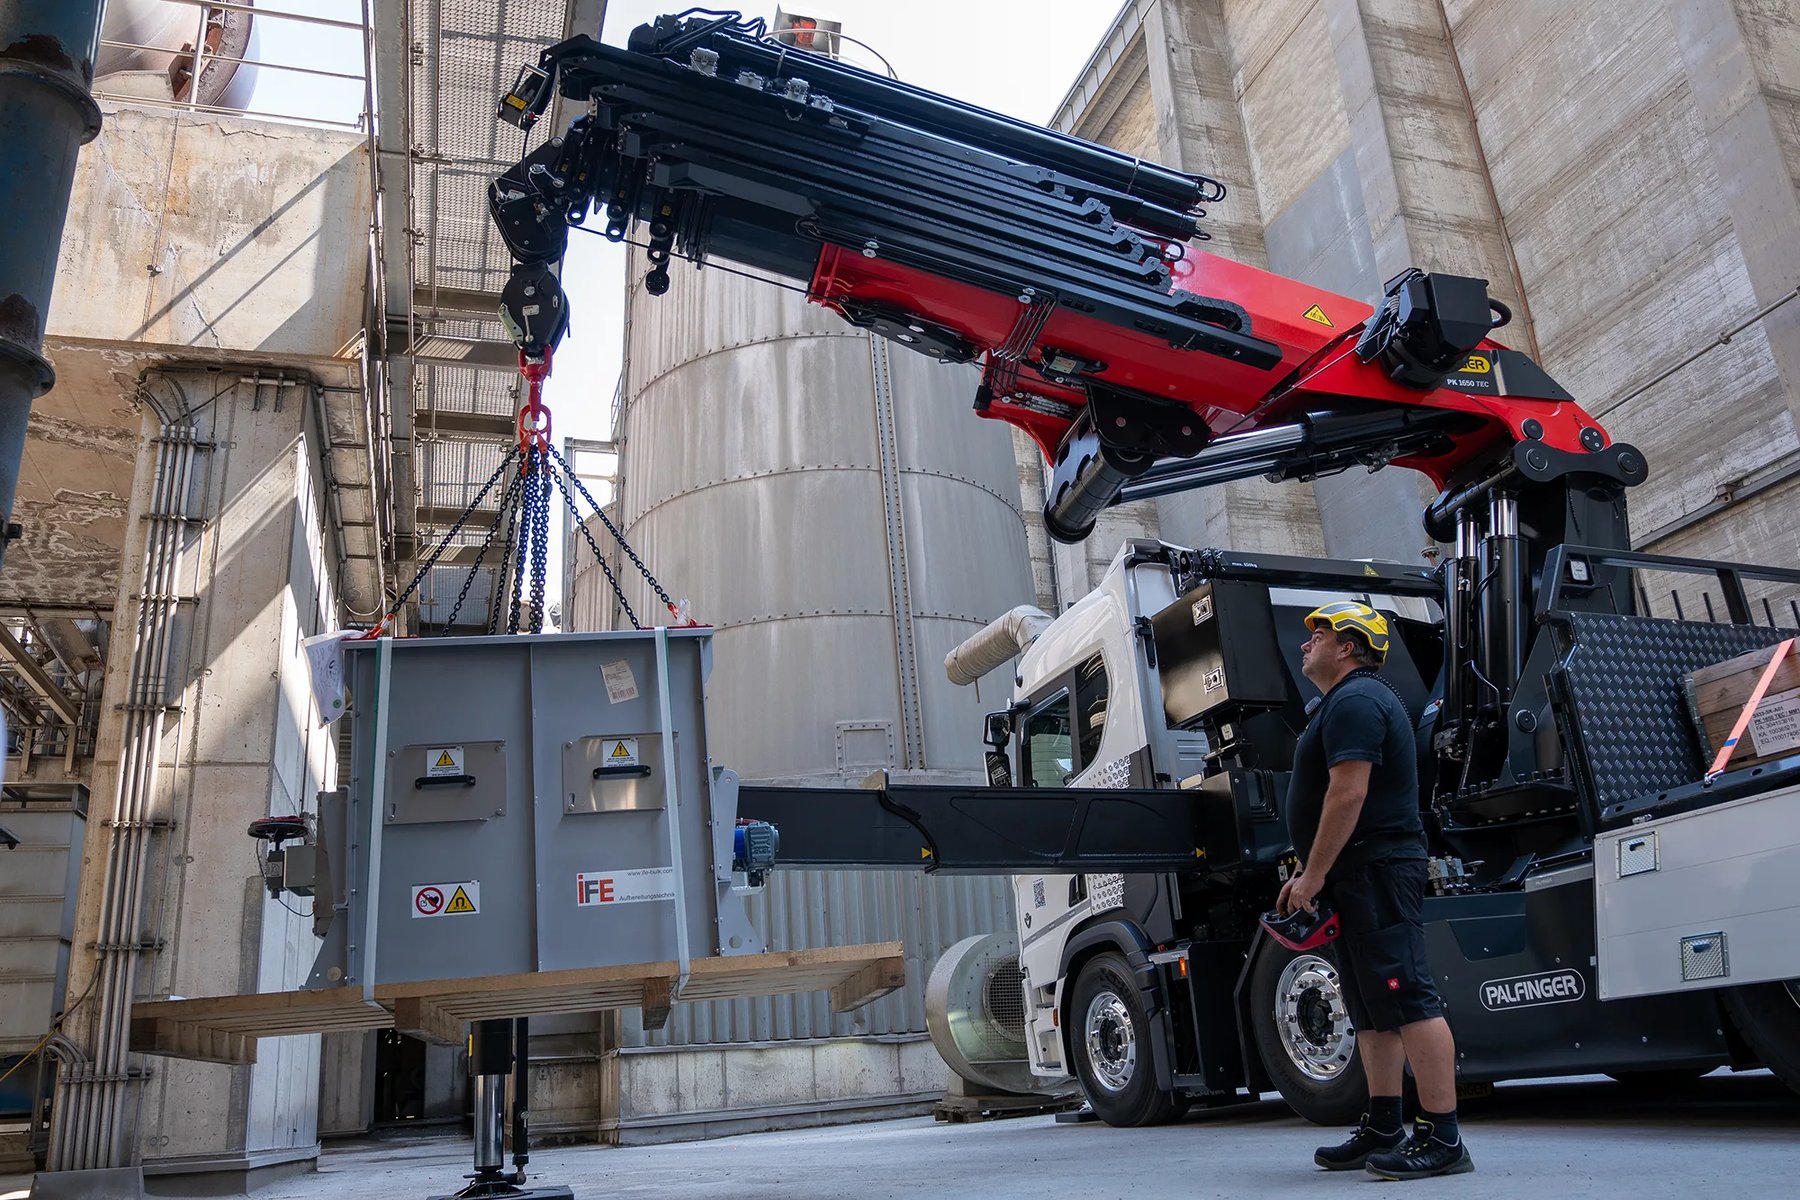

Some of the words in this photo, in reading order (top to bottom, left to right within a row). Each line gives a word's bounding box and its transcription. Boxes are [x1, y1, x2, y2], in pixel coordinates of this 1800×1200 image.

[1447, 378, 1458, 386] PK
[1459, 379, 1475, 387] 1650
[1774, 711, 1785, 719] TEC
[1486, 975, 1578, 1005] PALFINGER
